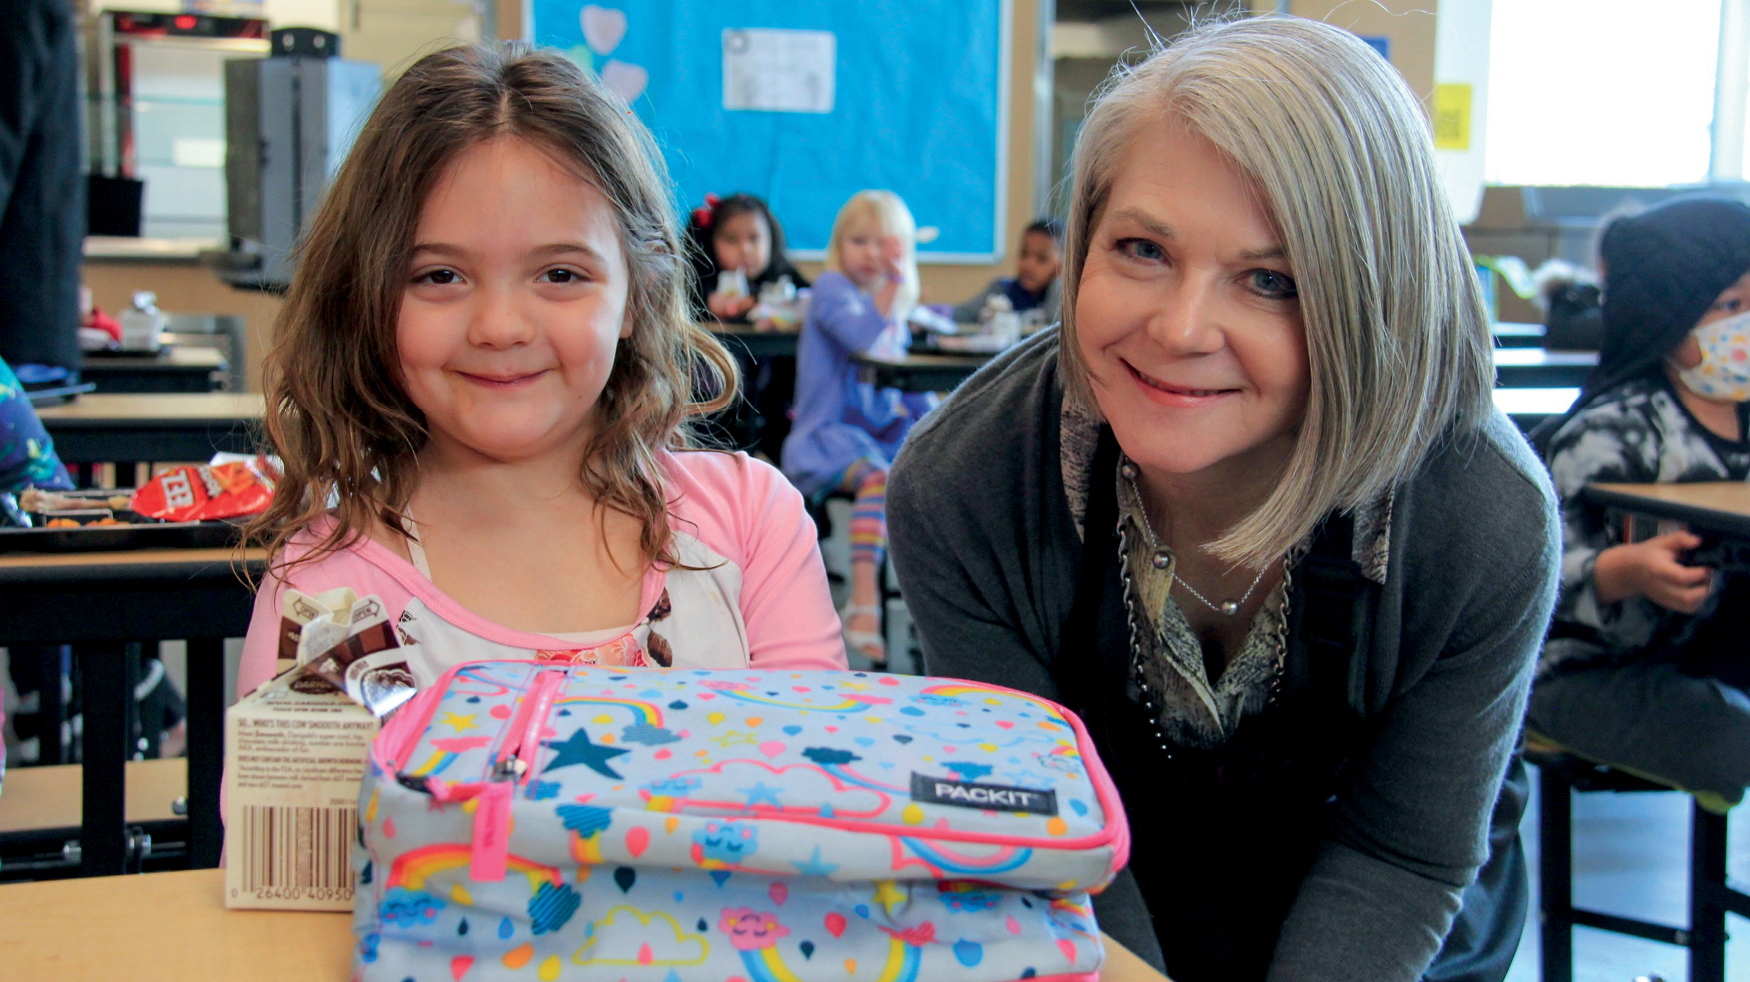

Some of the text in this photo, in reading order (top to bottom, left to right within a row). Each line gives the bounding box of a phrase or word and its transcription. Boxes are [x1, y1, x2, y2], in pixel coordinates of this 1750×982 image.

[253, 718, 275, 729] WHO'S
[276, 719, 291, 729] THIS
[292, 720, 307, 729] COW
[343, 721, 374, 731] ANYWAY?
[934, 782, 1032, 807] PACKIT
[231, 886, 352, 901] 0 26400 40950
